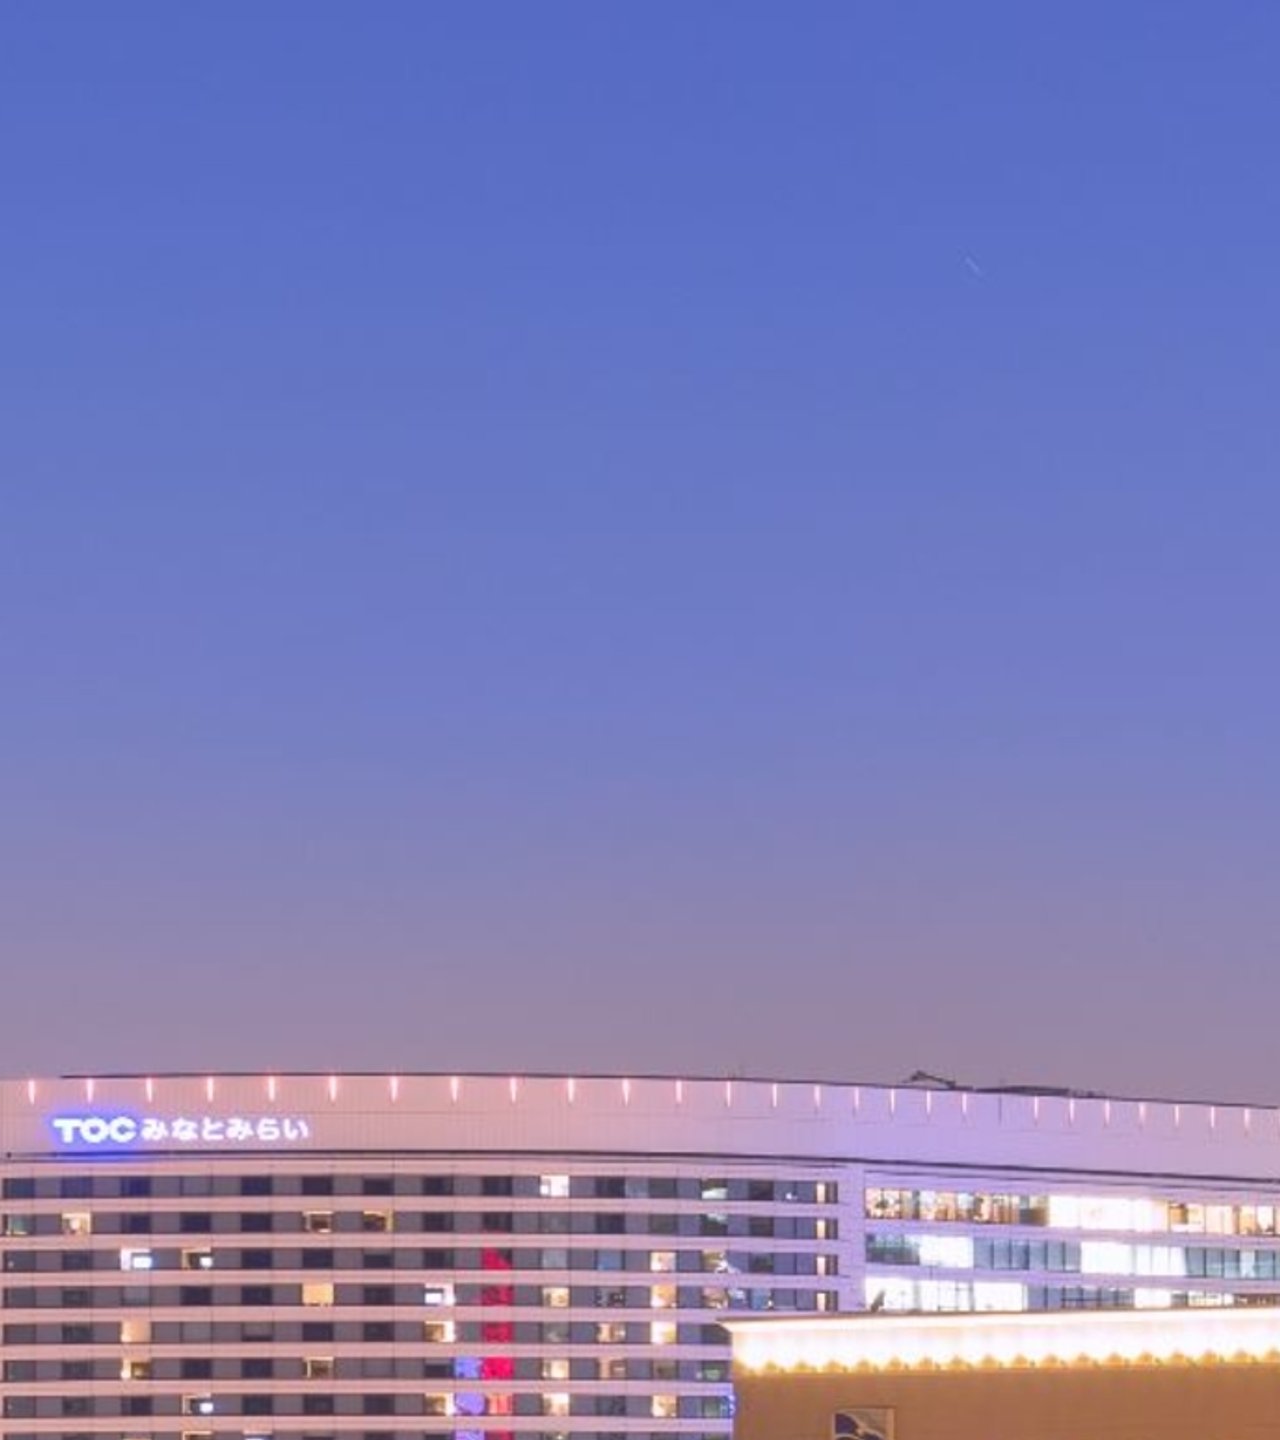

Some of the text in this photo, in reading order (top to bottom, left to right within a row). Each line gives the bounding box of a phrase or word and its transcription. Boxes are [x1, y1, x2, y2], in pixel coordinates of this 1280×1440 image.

[52, 1116, 309, 1143] TOC みなとみらい
